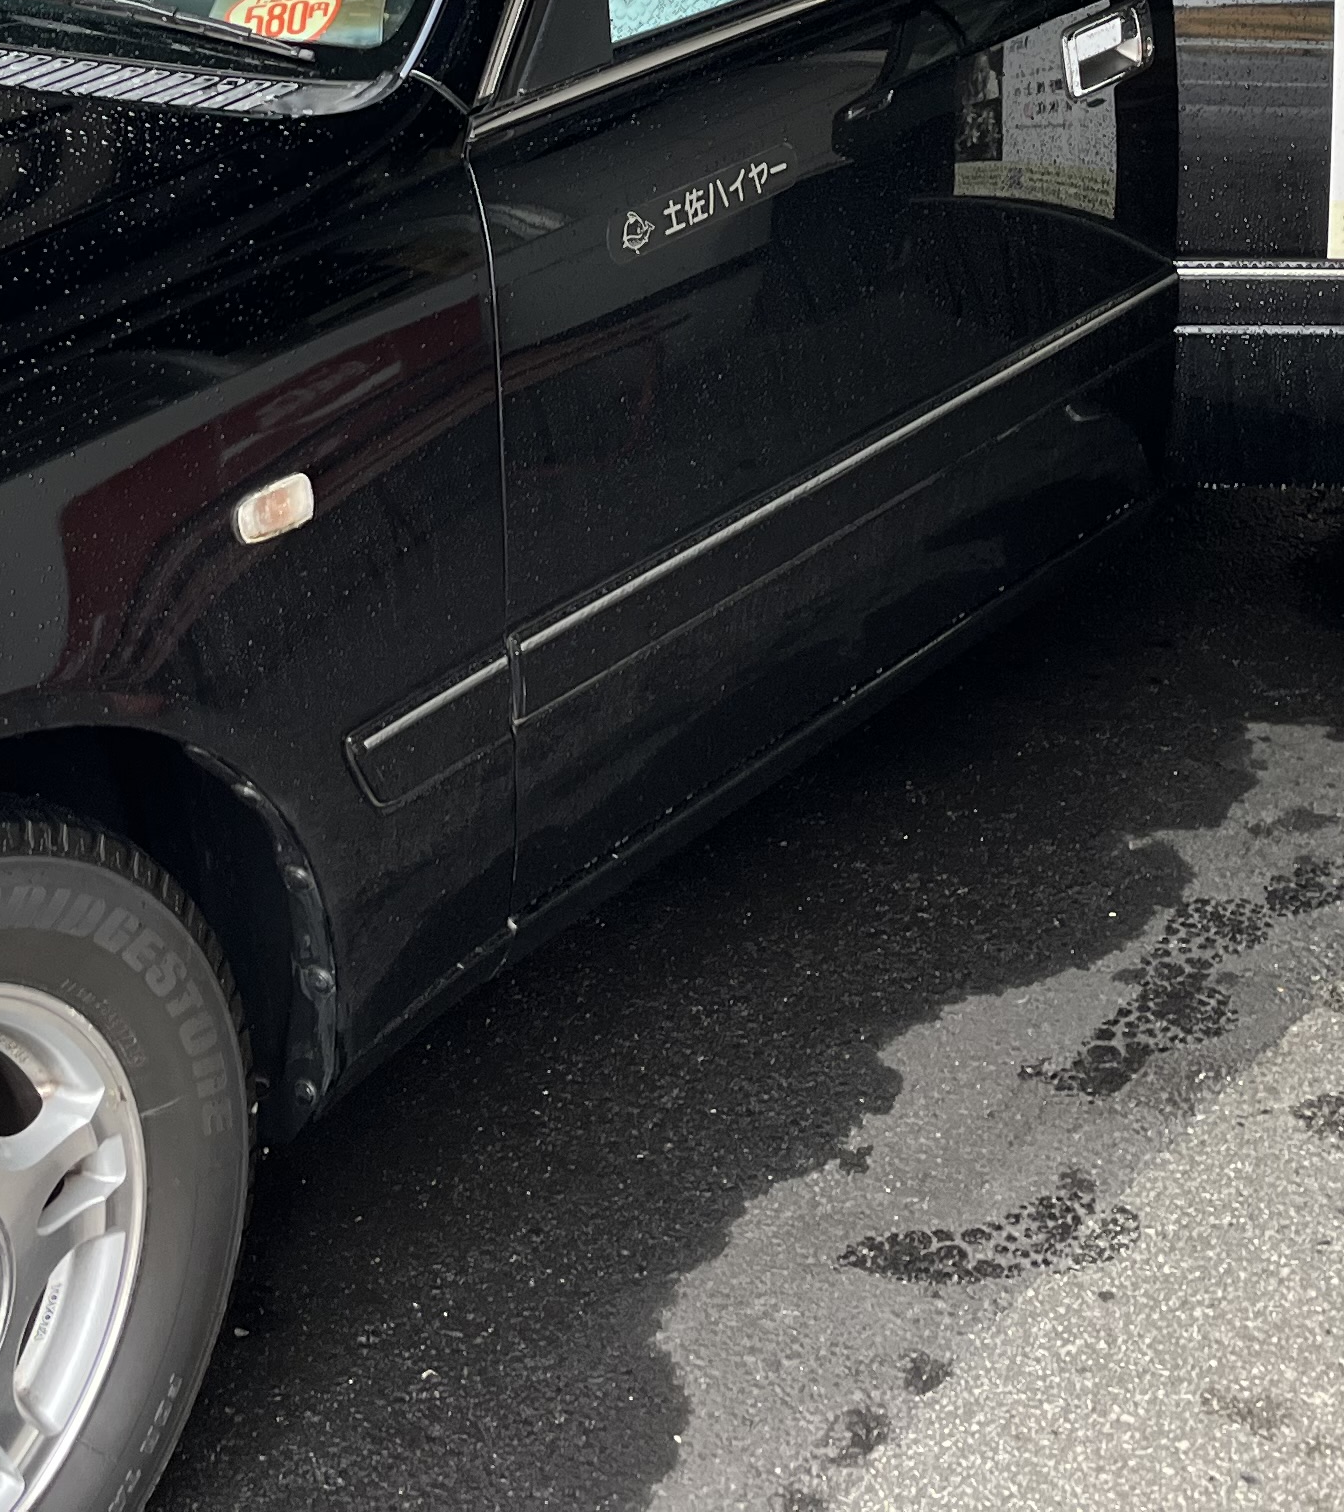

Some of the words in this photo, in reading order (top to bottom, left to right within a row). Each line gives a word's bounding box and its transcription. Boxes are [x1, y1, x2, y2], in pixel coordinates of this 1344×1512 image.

[662, 162, 788, 236] 土佐ハイヤー
